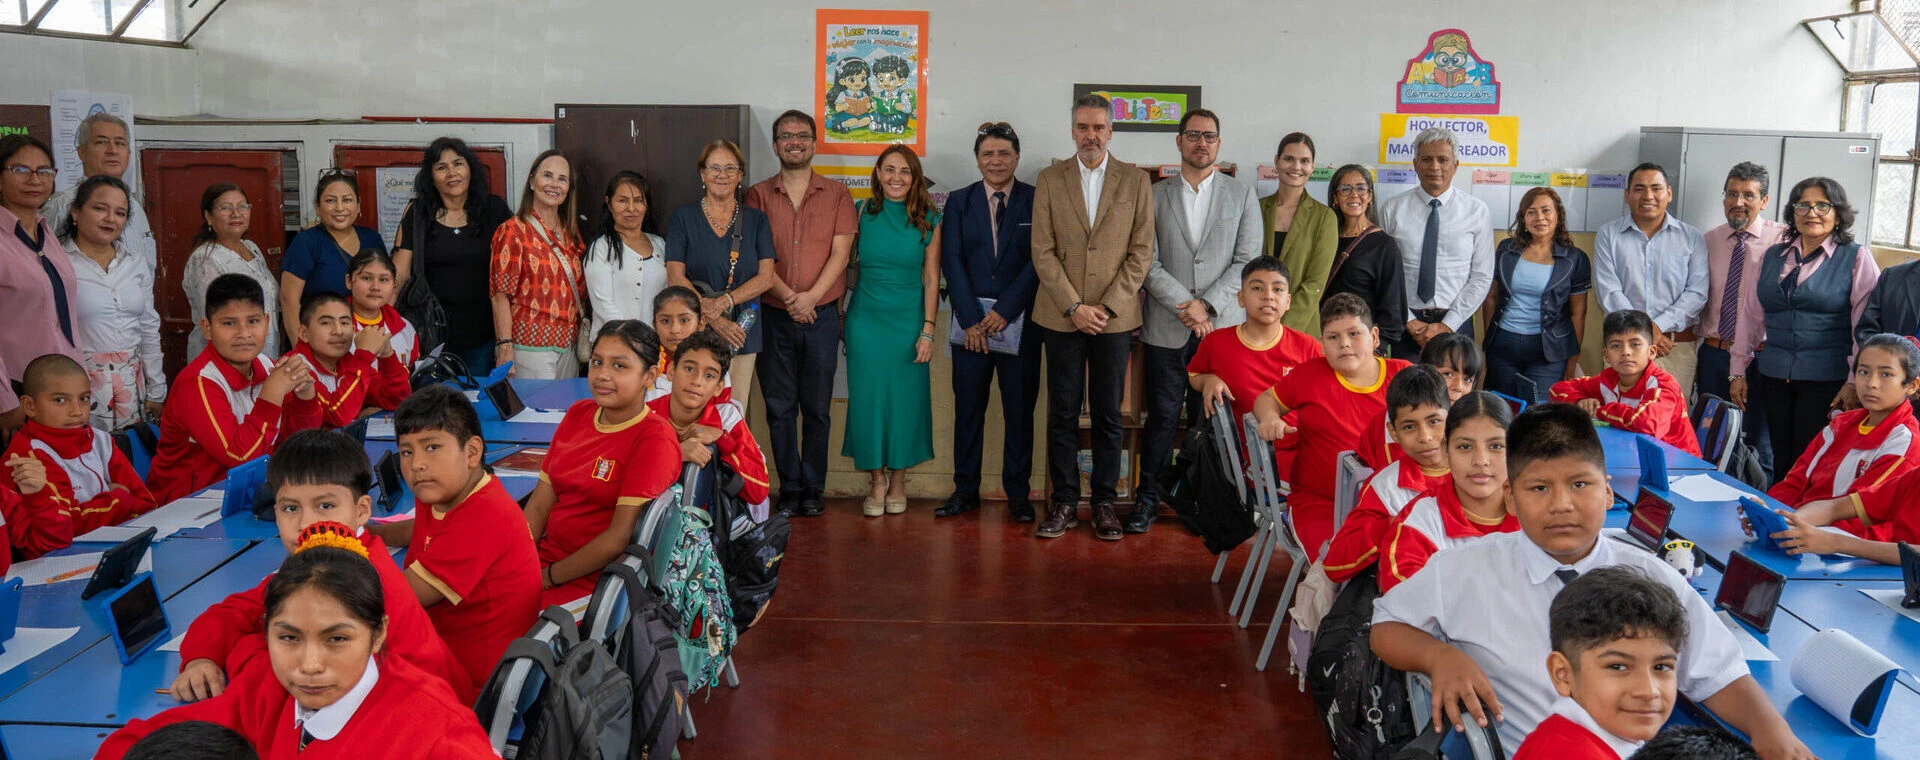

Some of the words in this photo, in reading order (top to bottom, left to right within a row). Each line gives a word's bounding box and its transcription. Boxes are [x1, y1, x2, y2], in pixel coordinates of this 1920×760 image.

[843, 26, 866, 37] Leer
[881, 27, 900, 36] hace
[1405, 88, 1492, 99] Comunicación
[1409, 120, 1435, 131] HOY
[1458, 145, 1506, 156] READOR
